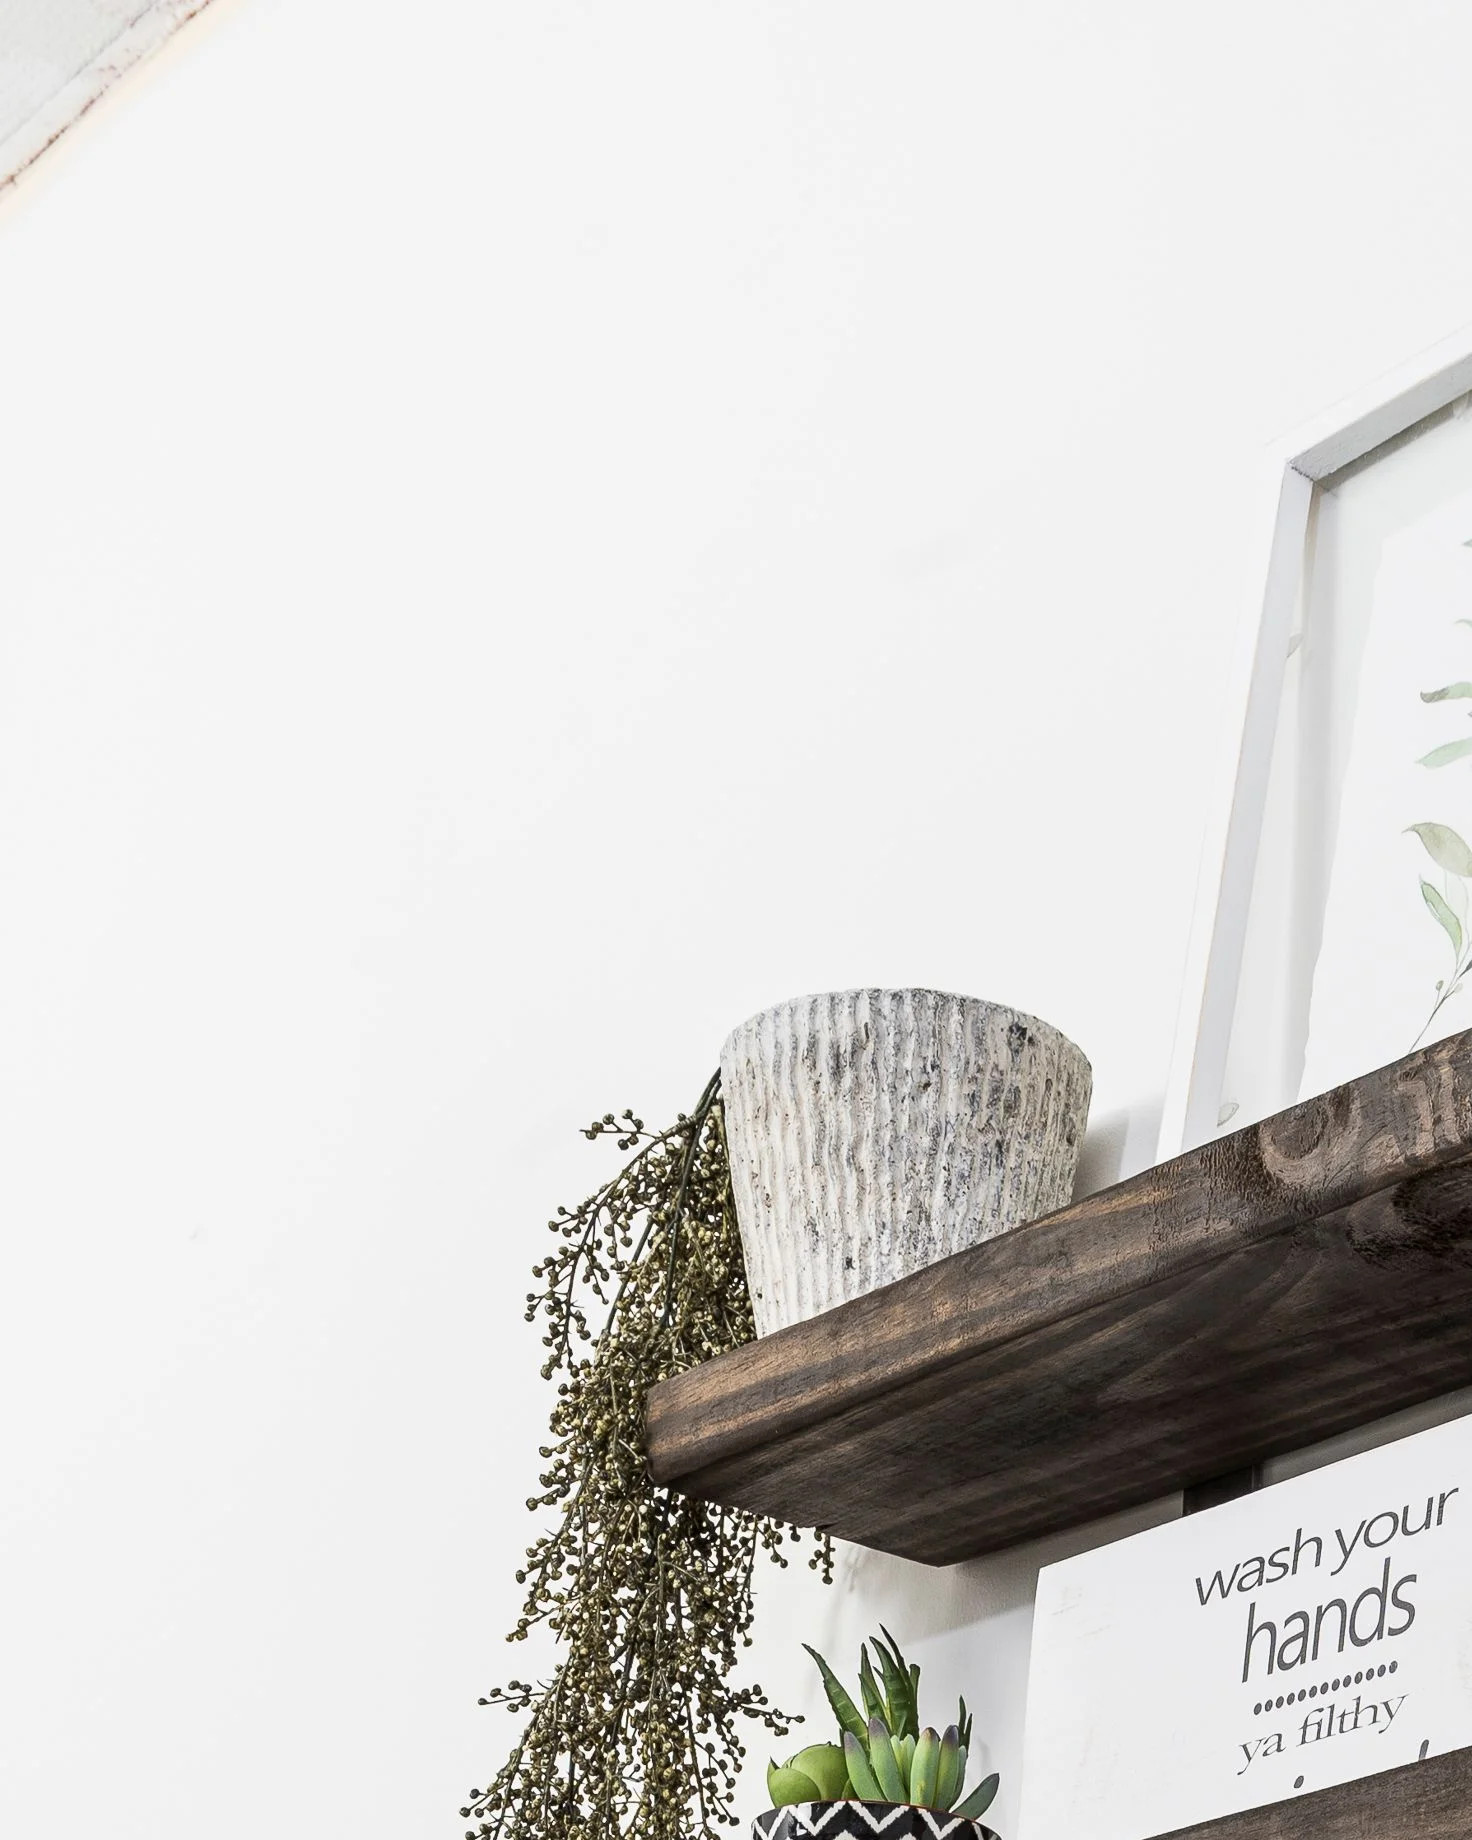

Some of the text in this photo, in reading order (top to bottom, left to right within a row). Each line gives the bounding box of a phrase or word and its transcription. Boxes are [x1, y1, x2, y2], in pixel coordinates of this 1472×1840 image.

[1194, 1487, 1459, 1606] wash your
[1241, 1556, 1418, 1684] hands
[1236, 1731, 1286, 1775] ya
[1297, 1693, 1408, 1749] filthy
